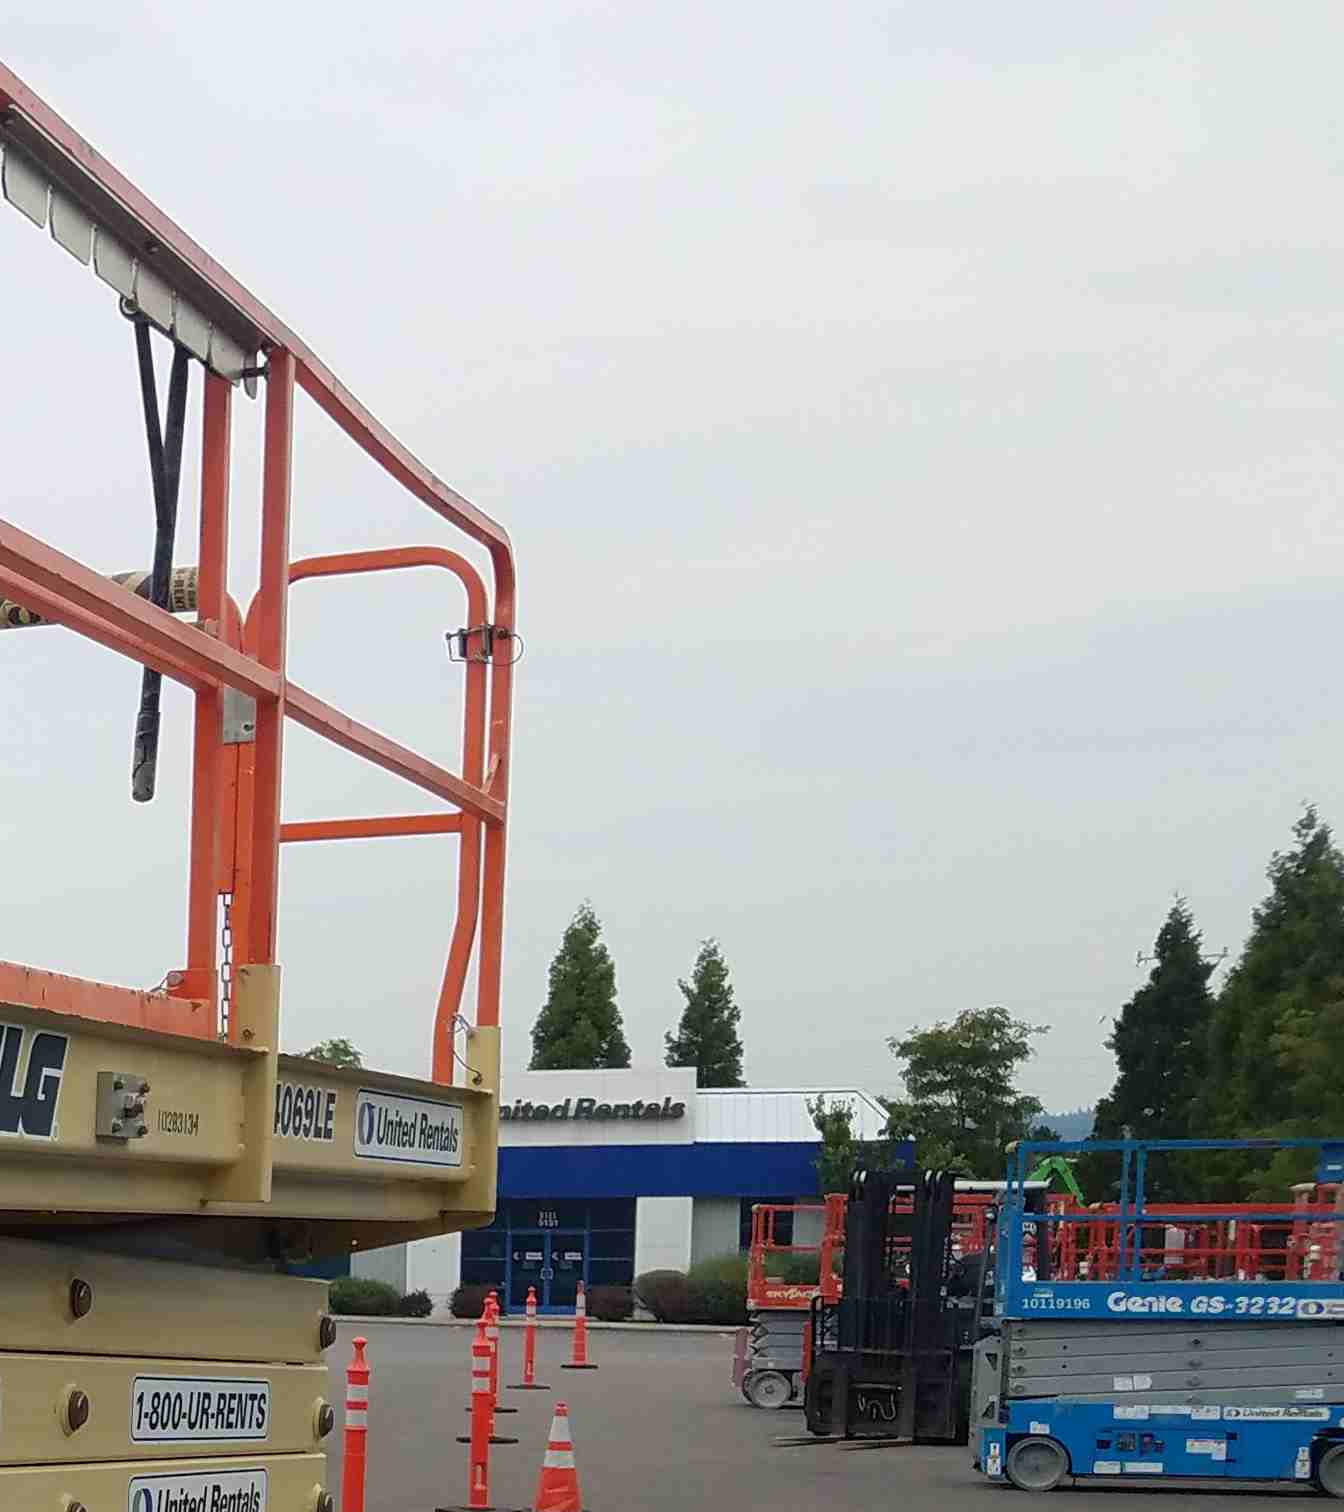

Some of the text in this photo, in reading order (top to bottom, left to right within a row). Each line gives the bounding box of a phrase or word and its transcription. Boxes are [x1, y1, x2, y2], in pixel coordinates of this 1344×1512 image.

[499, 1096, 686, 1120] nited Rentals
[375, 1106, 459, 1153] United Rentals
[1021, 1298, 1090, 1310] 10119196
[1107, 1291, 1297, 1315] Genie GS-3232
[135, 1391, 267, 1431] 1-800-UR-RENTS
